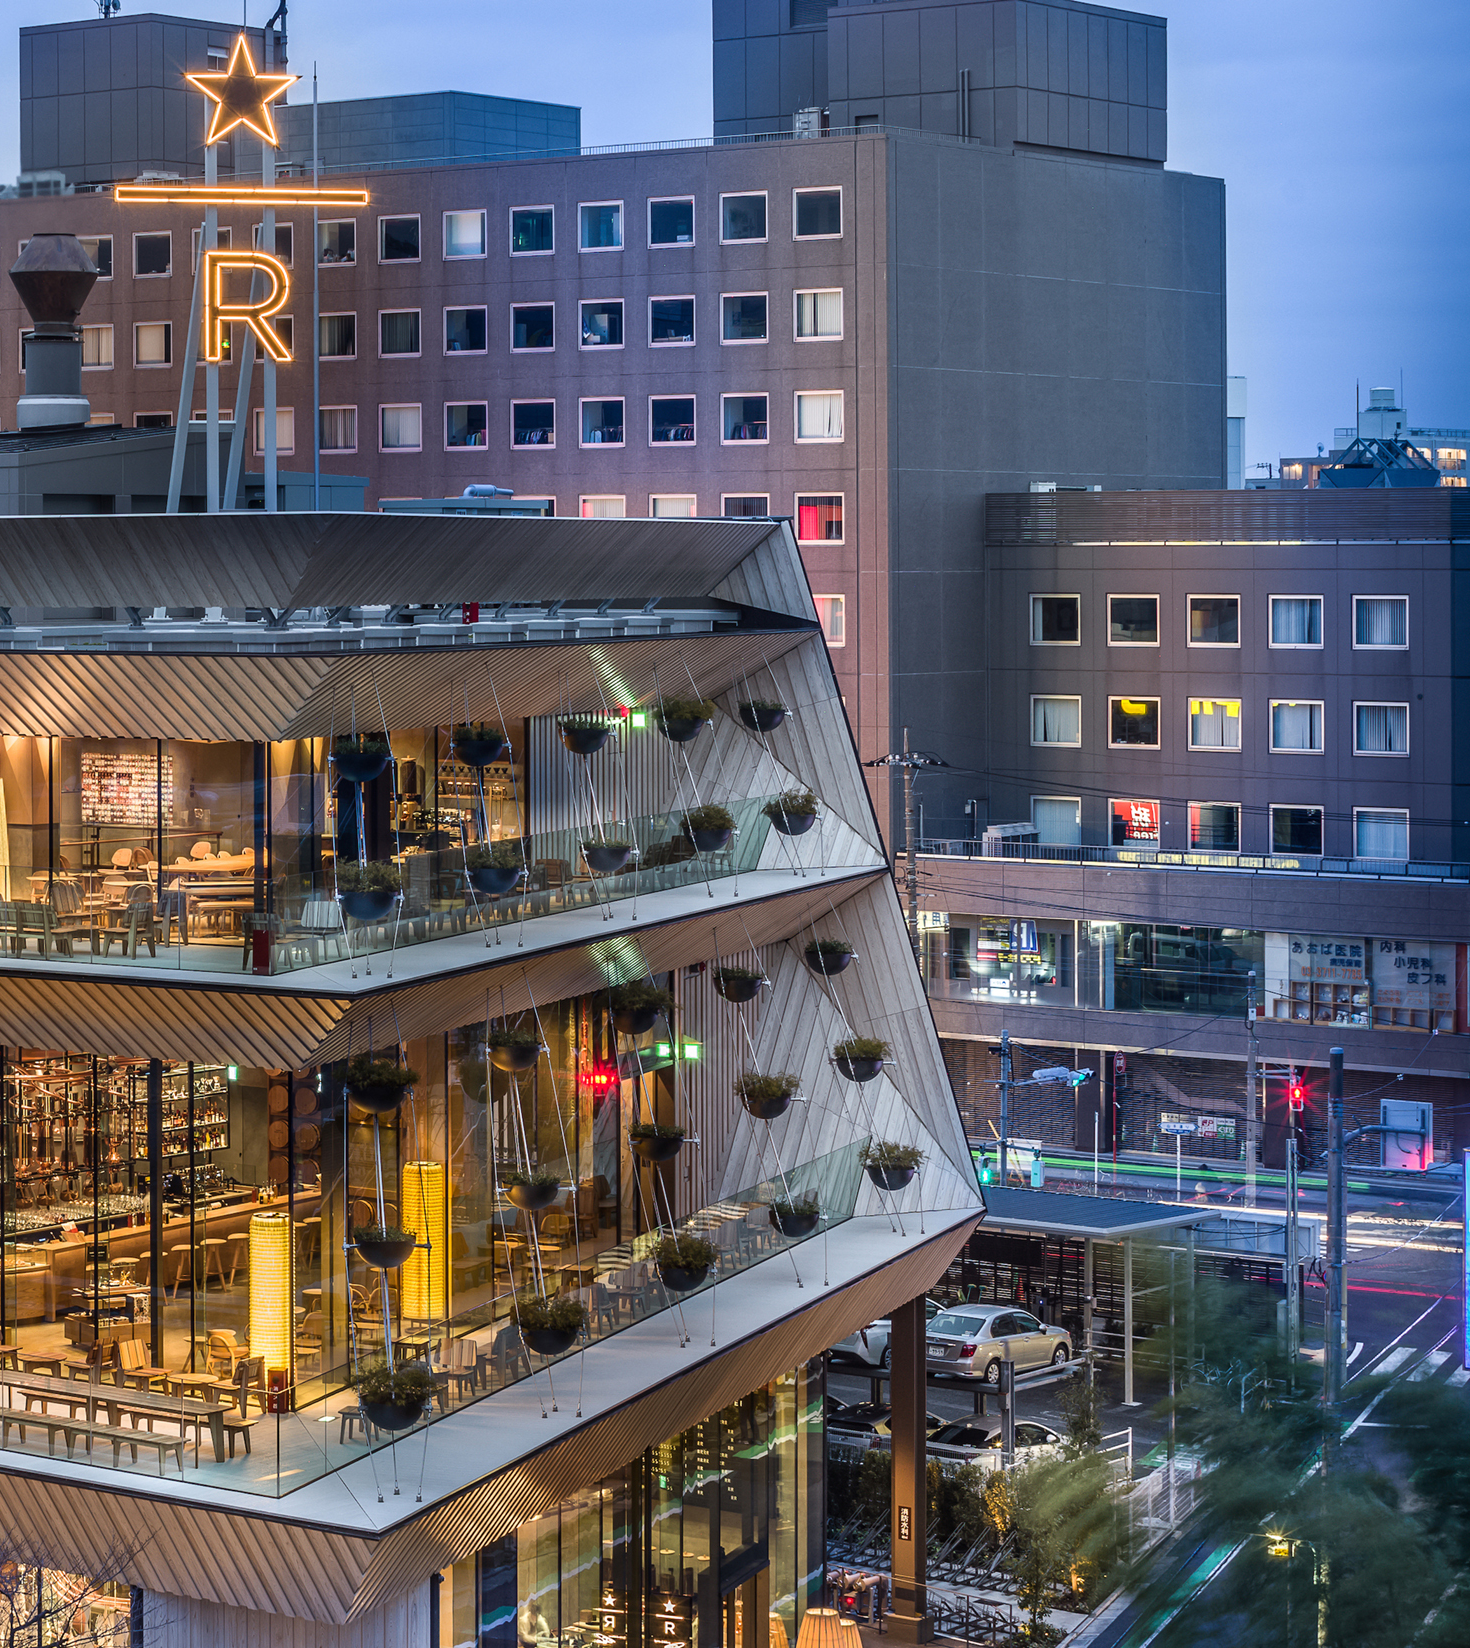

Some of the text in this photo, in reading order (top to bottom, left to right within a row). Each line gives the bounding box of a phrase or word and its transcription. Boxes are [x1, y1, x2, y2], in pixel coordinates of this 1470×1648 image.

[204, 250, 293, 362] R
[1291, 941, 1362, 958] あおば医院
[1380, 940, 1406, 954] 内科
[1394, 956, 1432, 970] 小児科
[1407, 972, 1447, 986] 皮フ科
[901, 1508, 909, 1536] 消防水利
[664, 1621, 676, 1635] R
